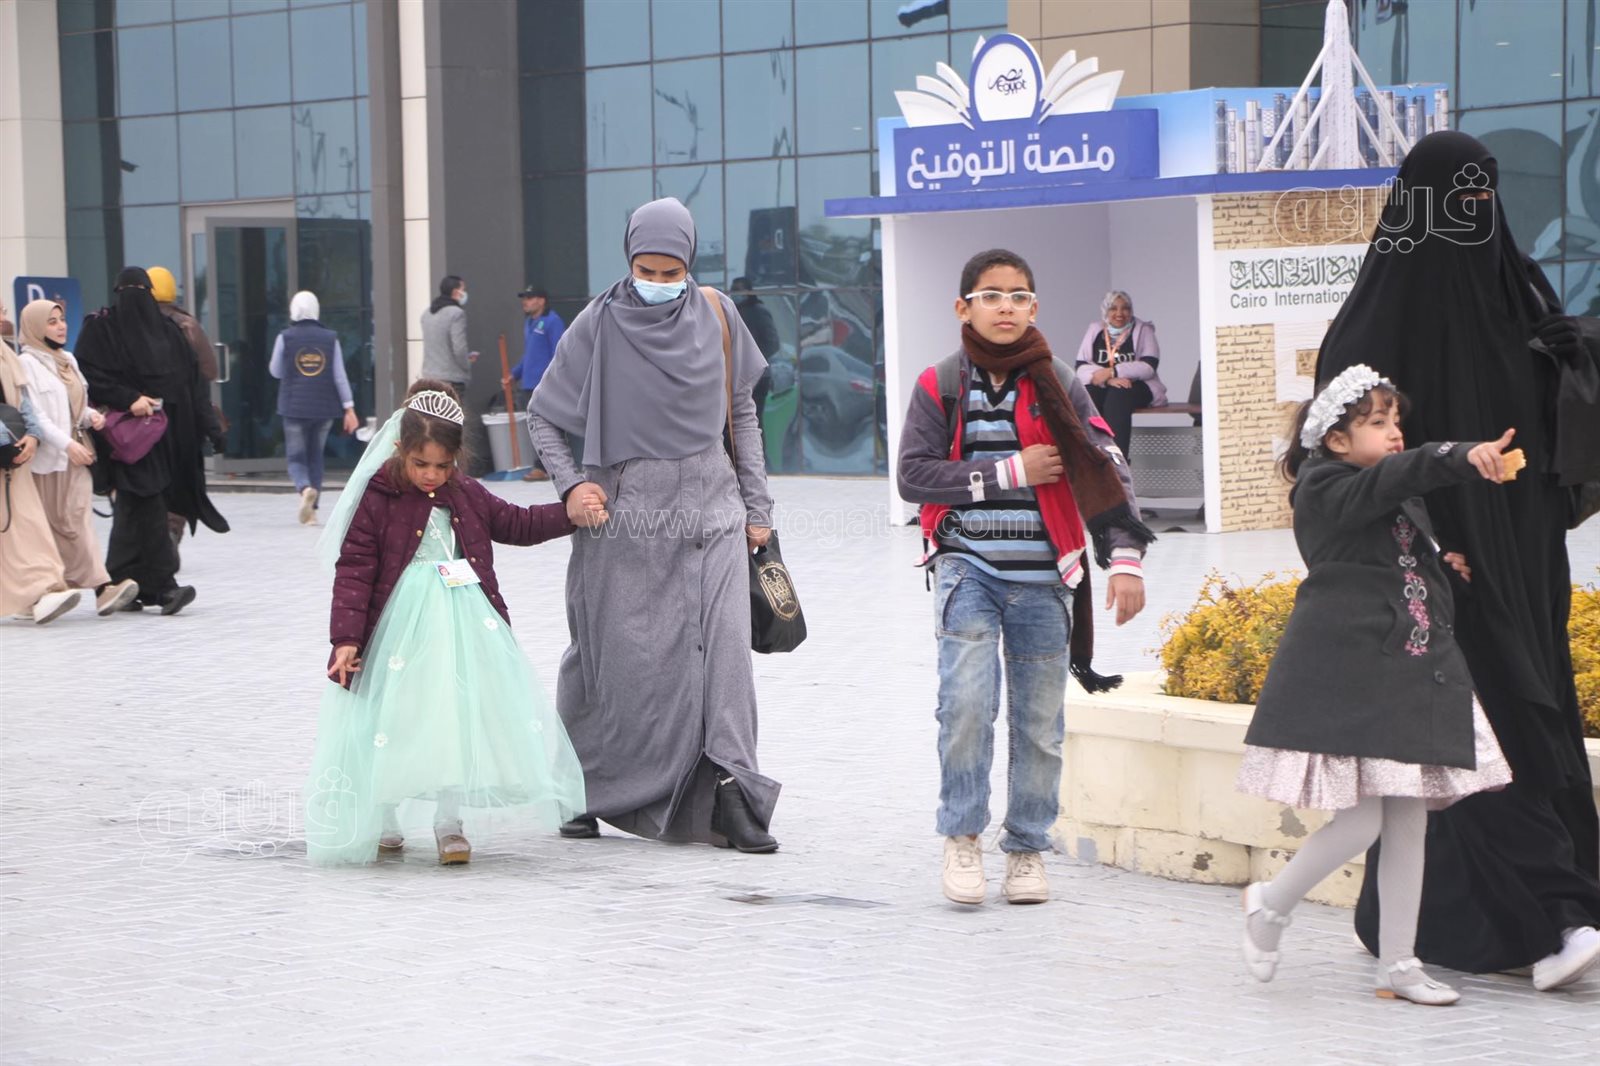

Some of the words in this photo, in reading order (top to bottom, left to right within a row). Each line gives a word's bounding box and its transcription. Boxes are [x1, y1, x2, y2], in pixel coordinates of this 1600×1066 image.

[996, 79, 1027, 96] Egypt
[907, 139, 1015, 190] التوقيع
[1023, 133, 1115, 173] منصة
[1230, 293, 1267, 309] Cairo
[1275, 289, 1348, 306] Internation
